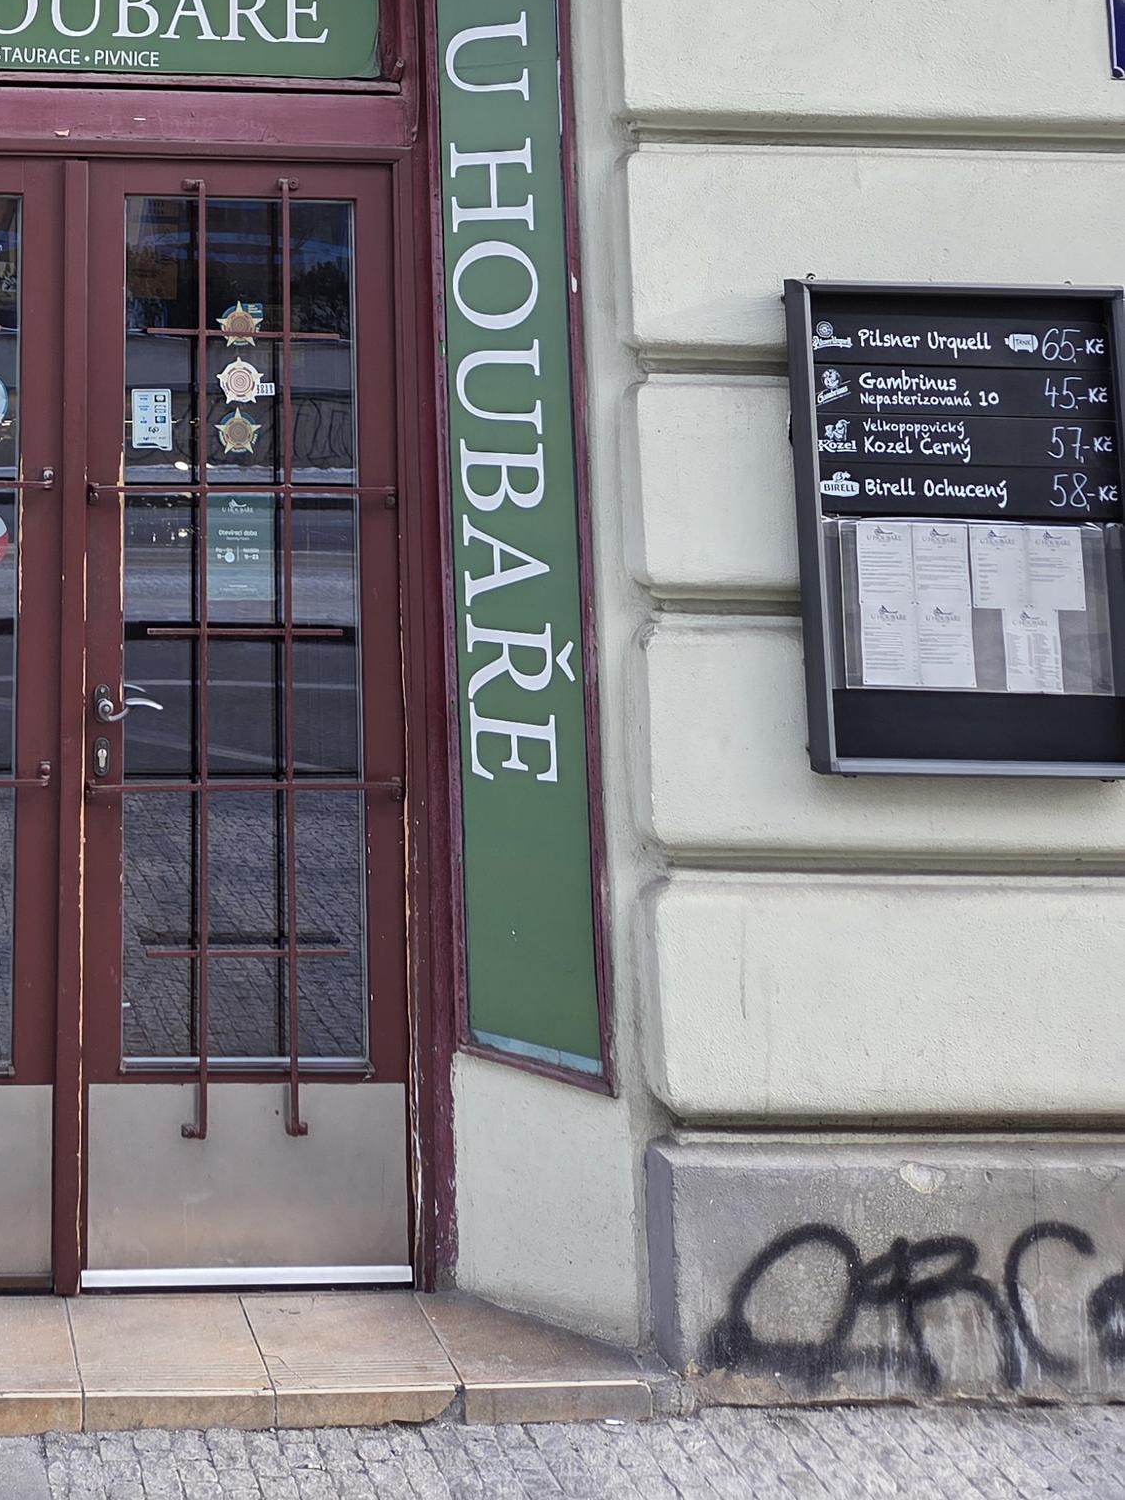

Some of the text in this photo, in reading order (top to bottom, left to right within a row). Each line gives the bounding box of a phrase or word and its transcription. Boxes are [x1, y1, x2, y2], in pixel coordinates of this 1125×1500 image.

[94, 50, 160, 67] PIVNICE
[858, 329, 921, 349] Pilsner
[927, 331, 992, 359] Urquell
[1085, 339, 1105, 354] Kč
[444, 10, 576, 783] U HOUBAŘE
[859, 369, 957, 391] Gambrinus
[1088, 387, 1108, 403] Kč
[860, 391, 999, 412] Nepasterizovaná 10
[863, 418, 965, 439] Velkopopovický
[818, 440, 857, 452] Kozel
[864, 435, 913, 454] Kozel
[920, 432, 971, 463] Černý
[1093, 436, 1113, 452] Kč
[824, 482, 857, 492] BIRELL
[865, 478, 916, 496] Birell
[924, 479, 1008, 508] Ochucený
[1098, 485, 1118, 501] Kč
